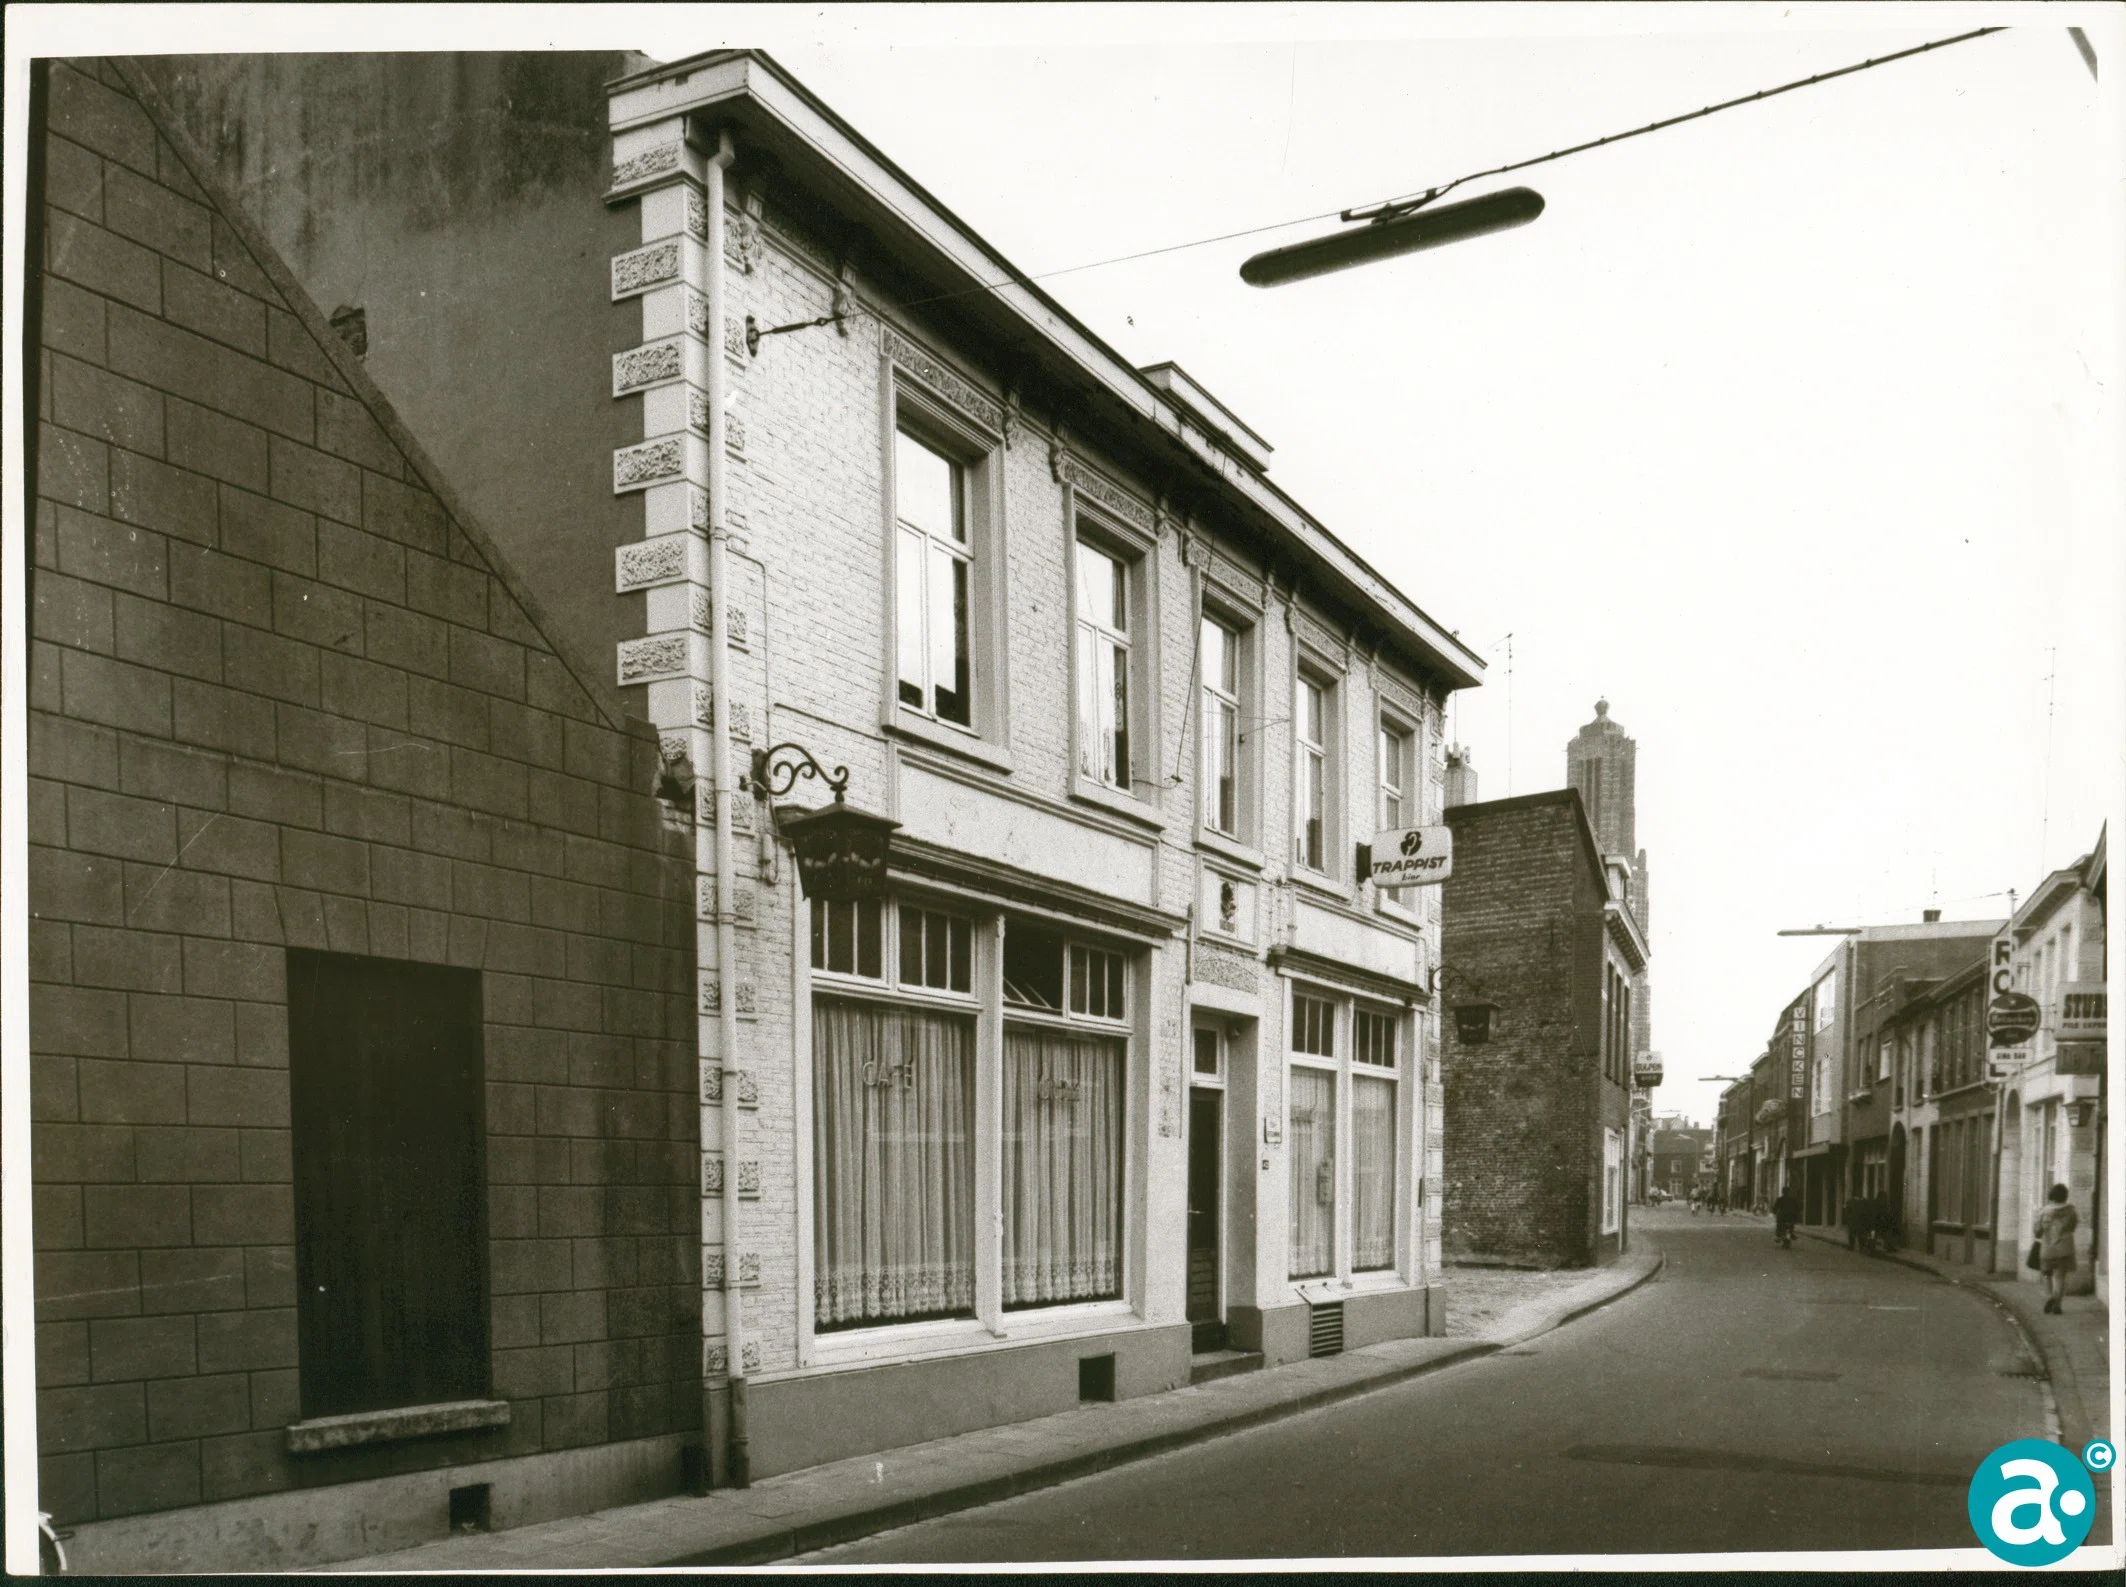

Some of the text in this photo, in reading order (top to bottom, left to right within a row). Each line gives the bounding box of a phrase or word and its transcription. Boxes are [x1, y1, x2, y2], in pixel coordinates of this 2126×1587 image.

[1373, 856, 1448, 874] TRAPPIST
[1792, 1008, 1805, 1097] VINCKEN
[1989, 941, 2016, 1077] ROL
